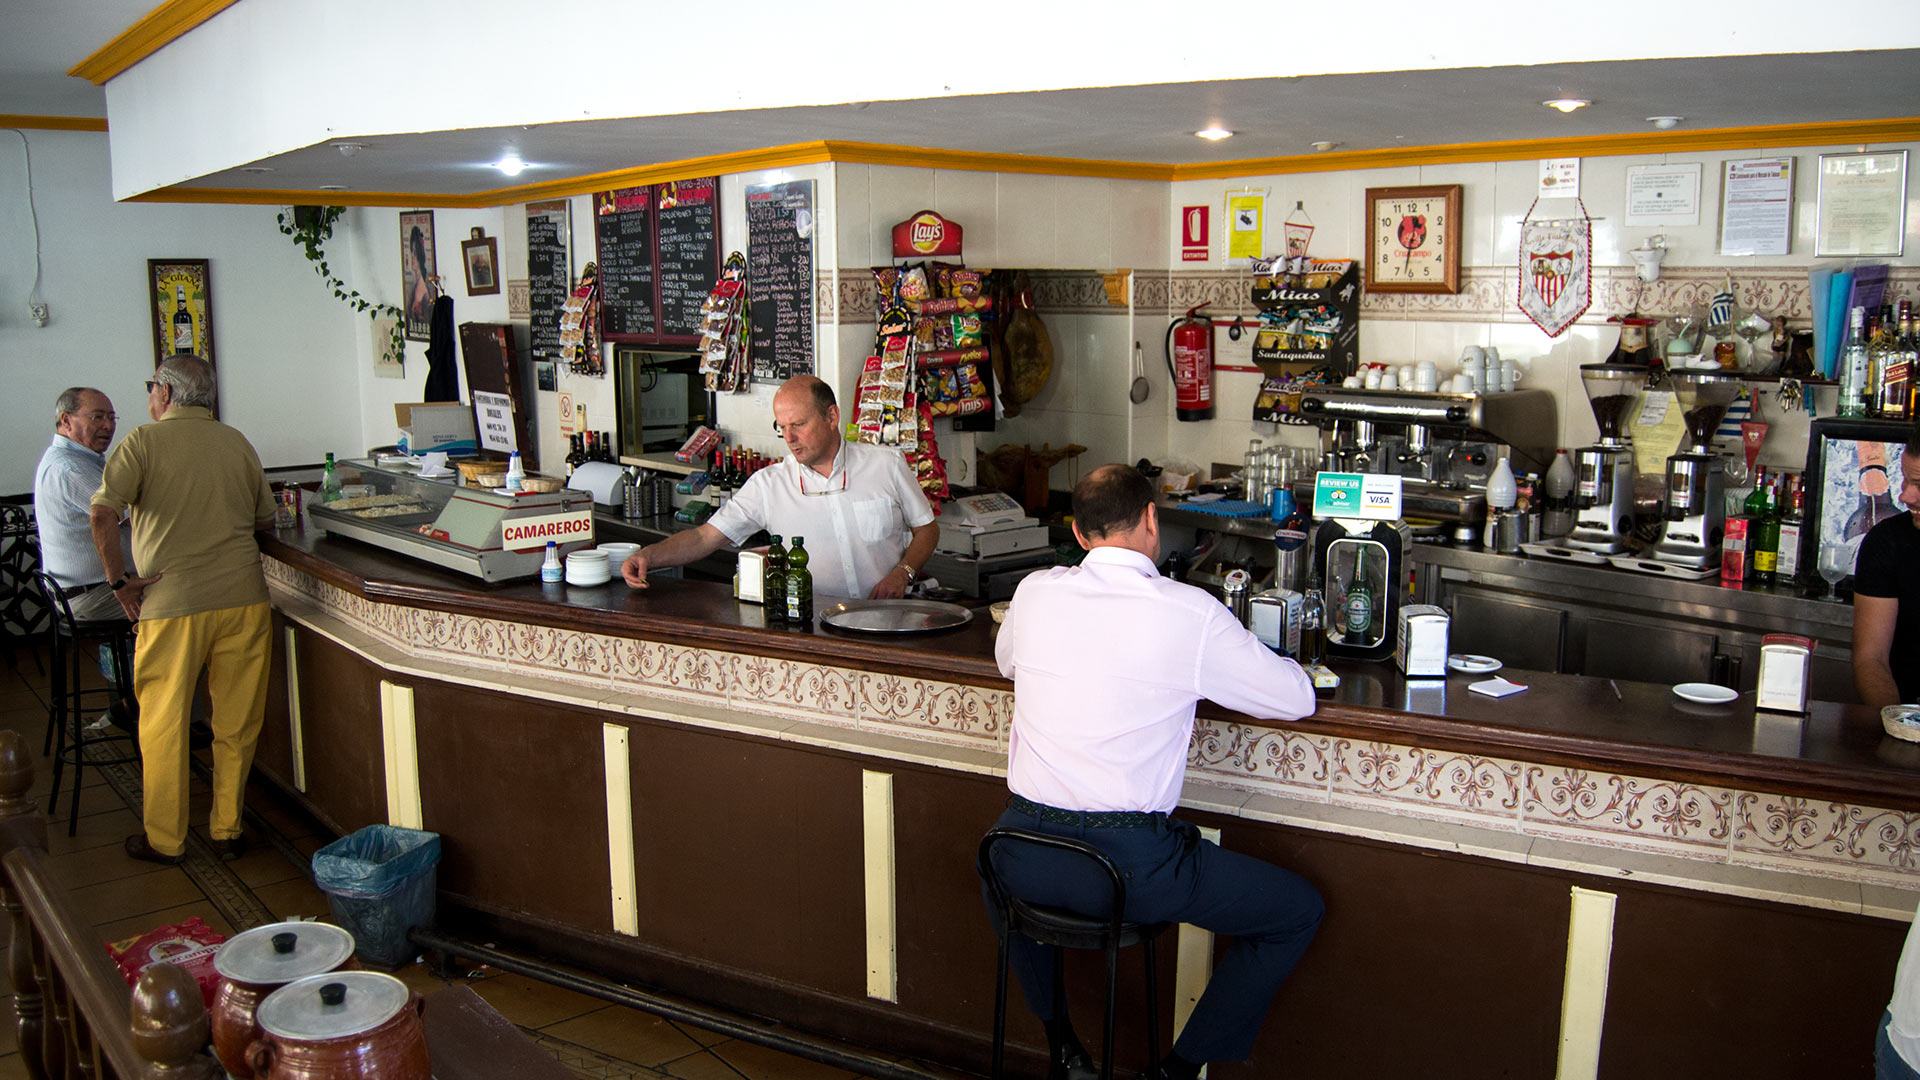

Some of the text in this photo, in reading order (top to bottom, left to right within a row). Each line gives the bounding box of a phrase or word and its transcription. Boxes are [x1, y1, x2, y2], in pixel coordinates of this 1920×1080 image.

[1394, 204, 1401, 213] 11
[1408, 203, 1417, 212] 12
[1426, 203, 1430, 212] 1
[1382, 217, 1391, 227] 10
[1437, 216, 1443, 225] 2
[1383, 236, 1389, 245] 9
[1437, 235, 1443, 245] 3
[1383, 254, 1388, 263] 8
[1435, 254, 1442, 263] 4
[1252, 262, 1272, 272] Mia
[1310, 262, 1342, 272] Mias
[1394, 267, 1400, 276] 7
[1424, 267, 1430, 276] 5
[1408, 269, 1414, 278] 6
[1261, 289, 1320, 301] Mias
[1262, 412, 1309, 424] Mia
[1320, 479, 1348, 487] REVIEW
[1370, 496, 1390, 504] VISA
[504, 519, 590, 541] CAMAREROS
